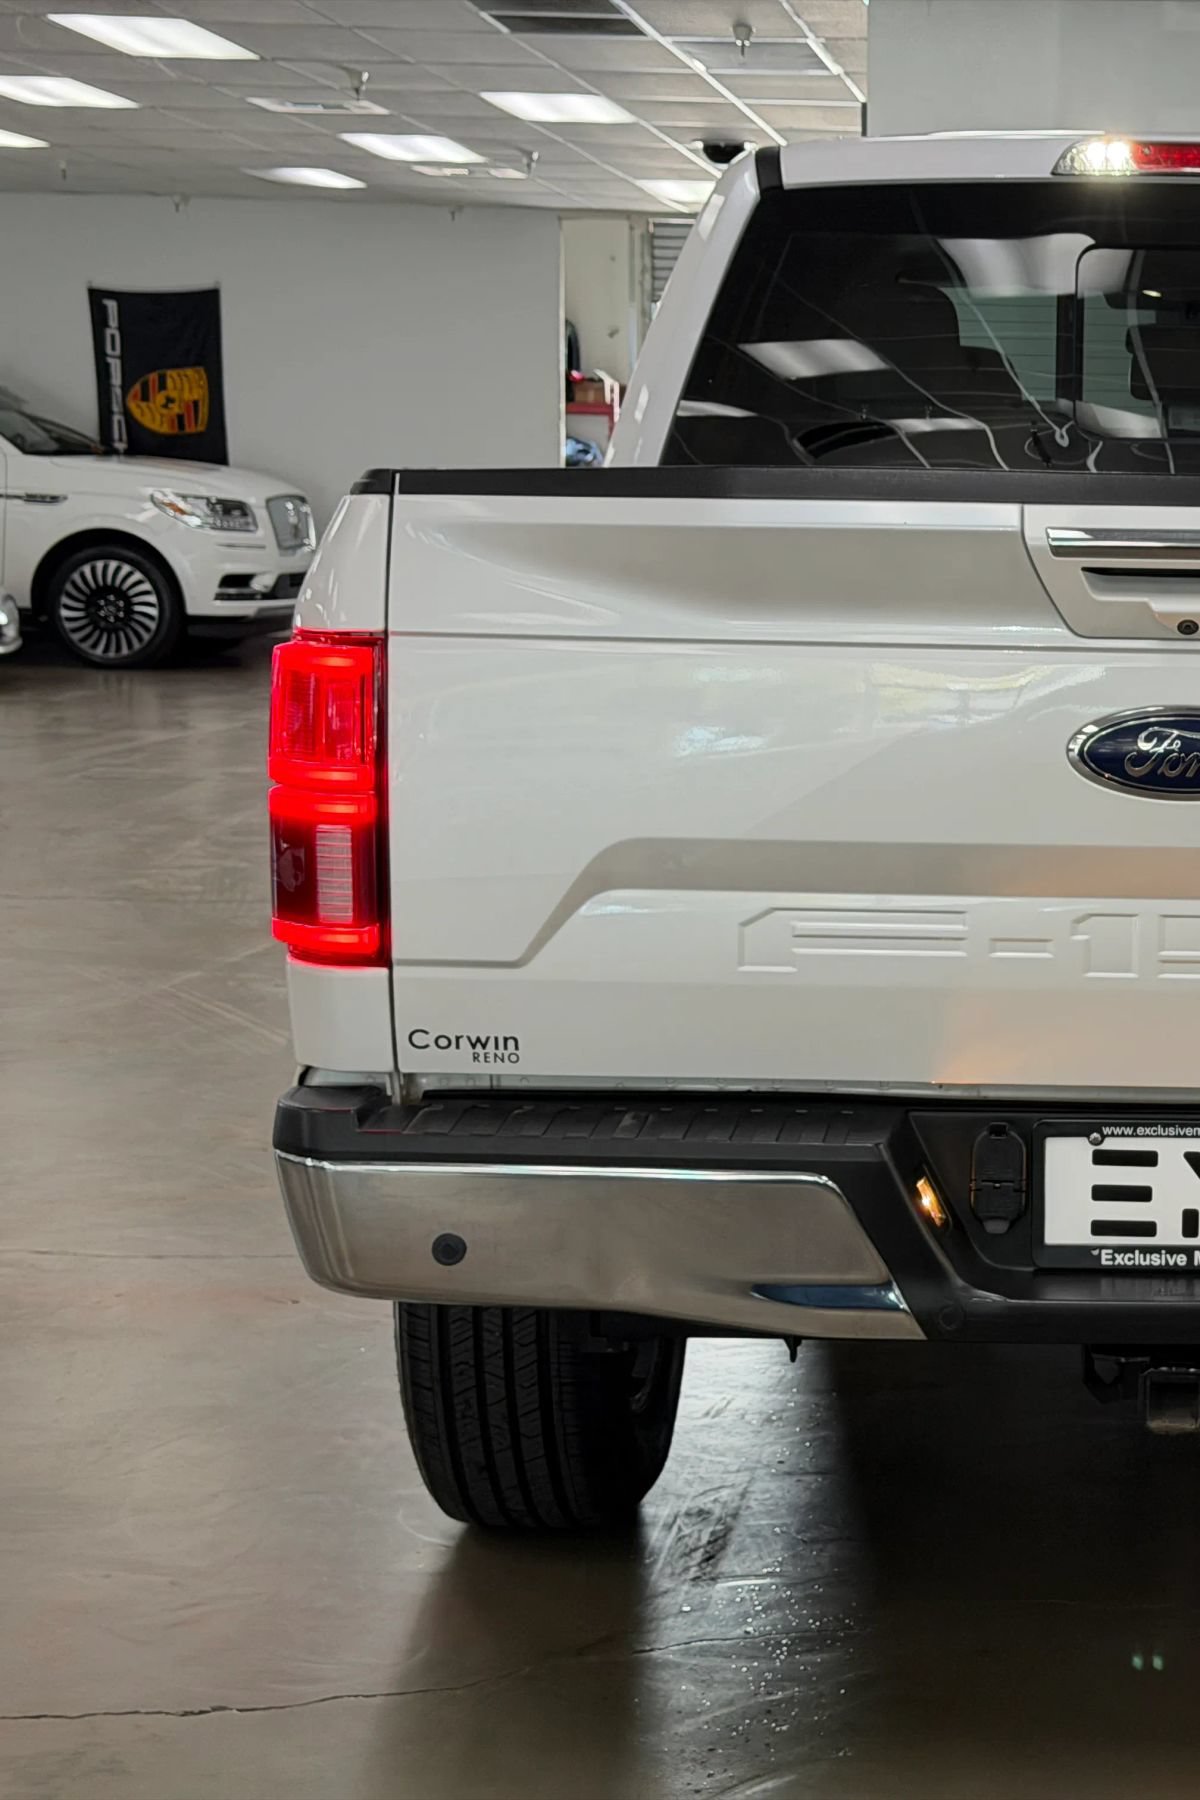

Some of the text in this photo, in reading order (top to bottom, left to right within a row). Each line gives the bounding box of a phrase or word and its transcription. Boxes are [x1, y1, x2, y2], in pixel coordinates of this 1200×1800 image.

[102, 299, 128, 457] PORSC
[408, 1028, 520, 1051] Corwin
[472, 1051, 520, 1064] RENO
[1100, 1249, 1188, 1267] Exclusive
